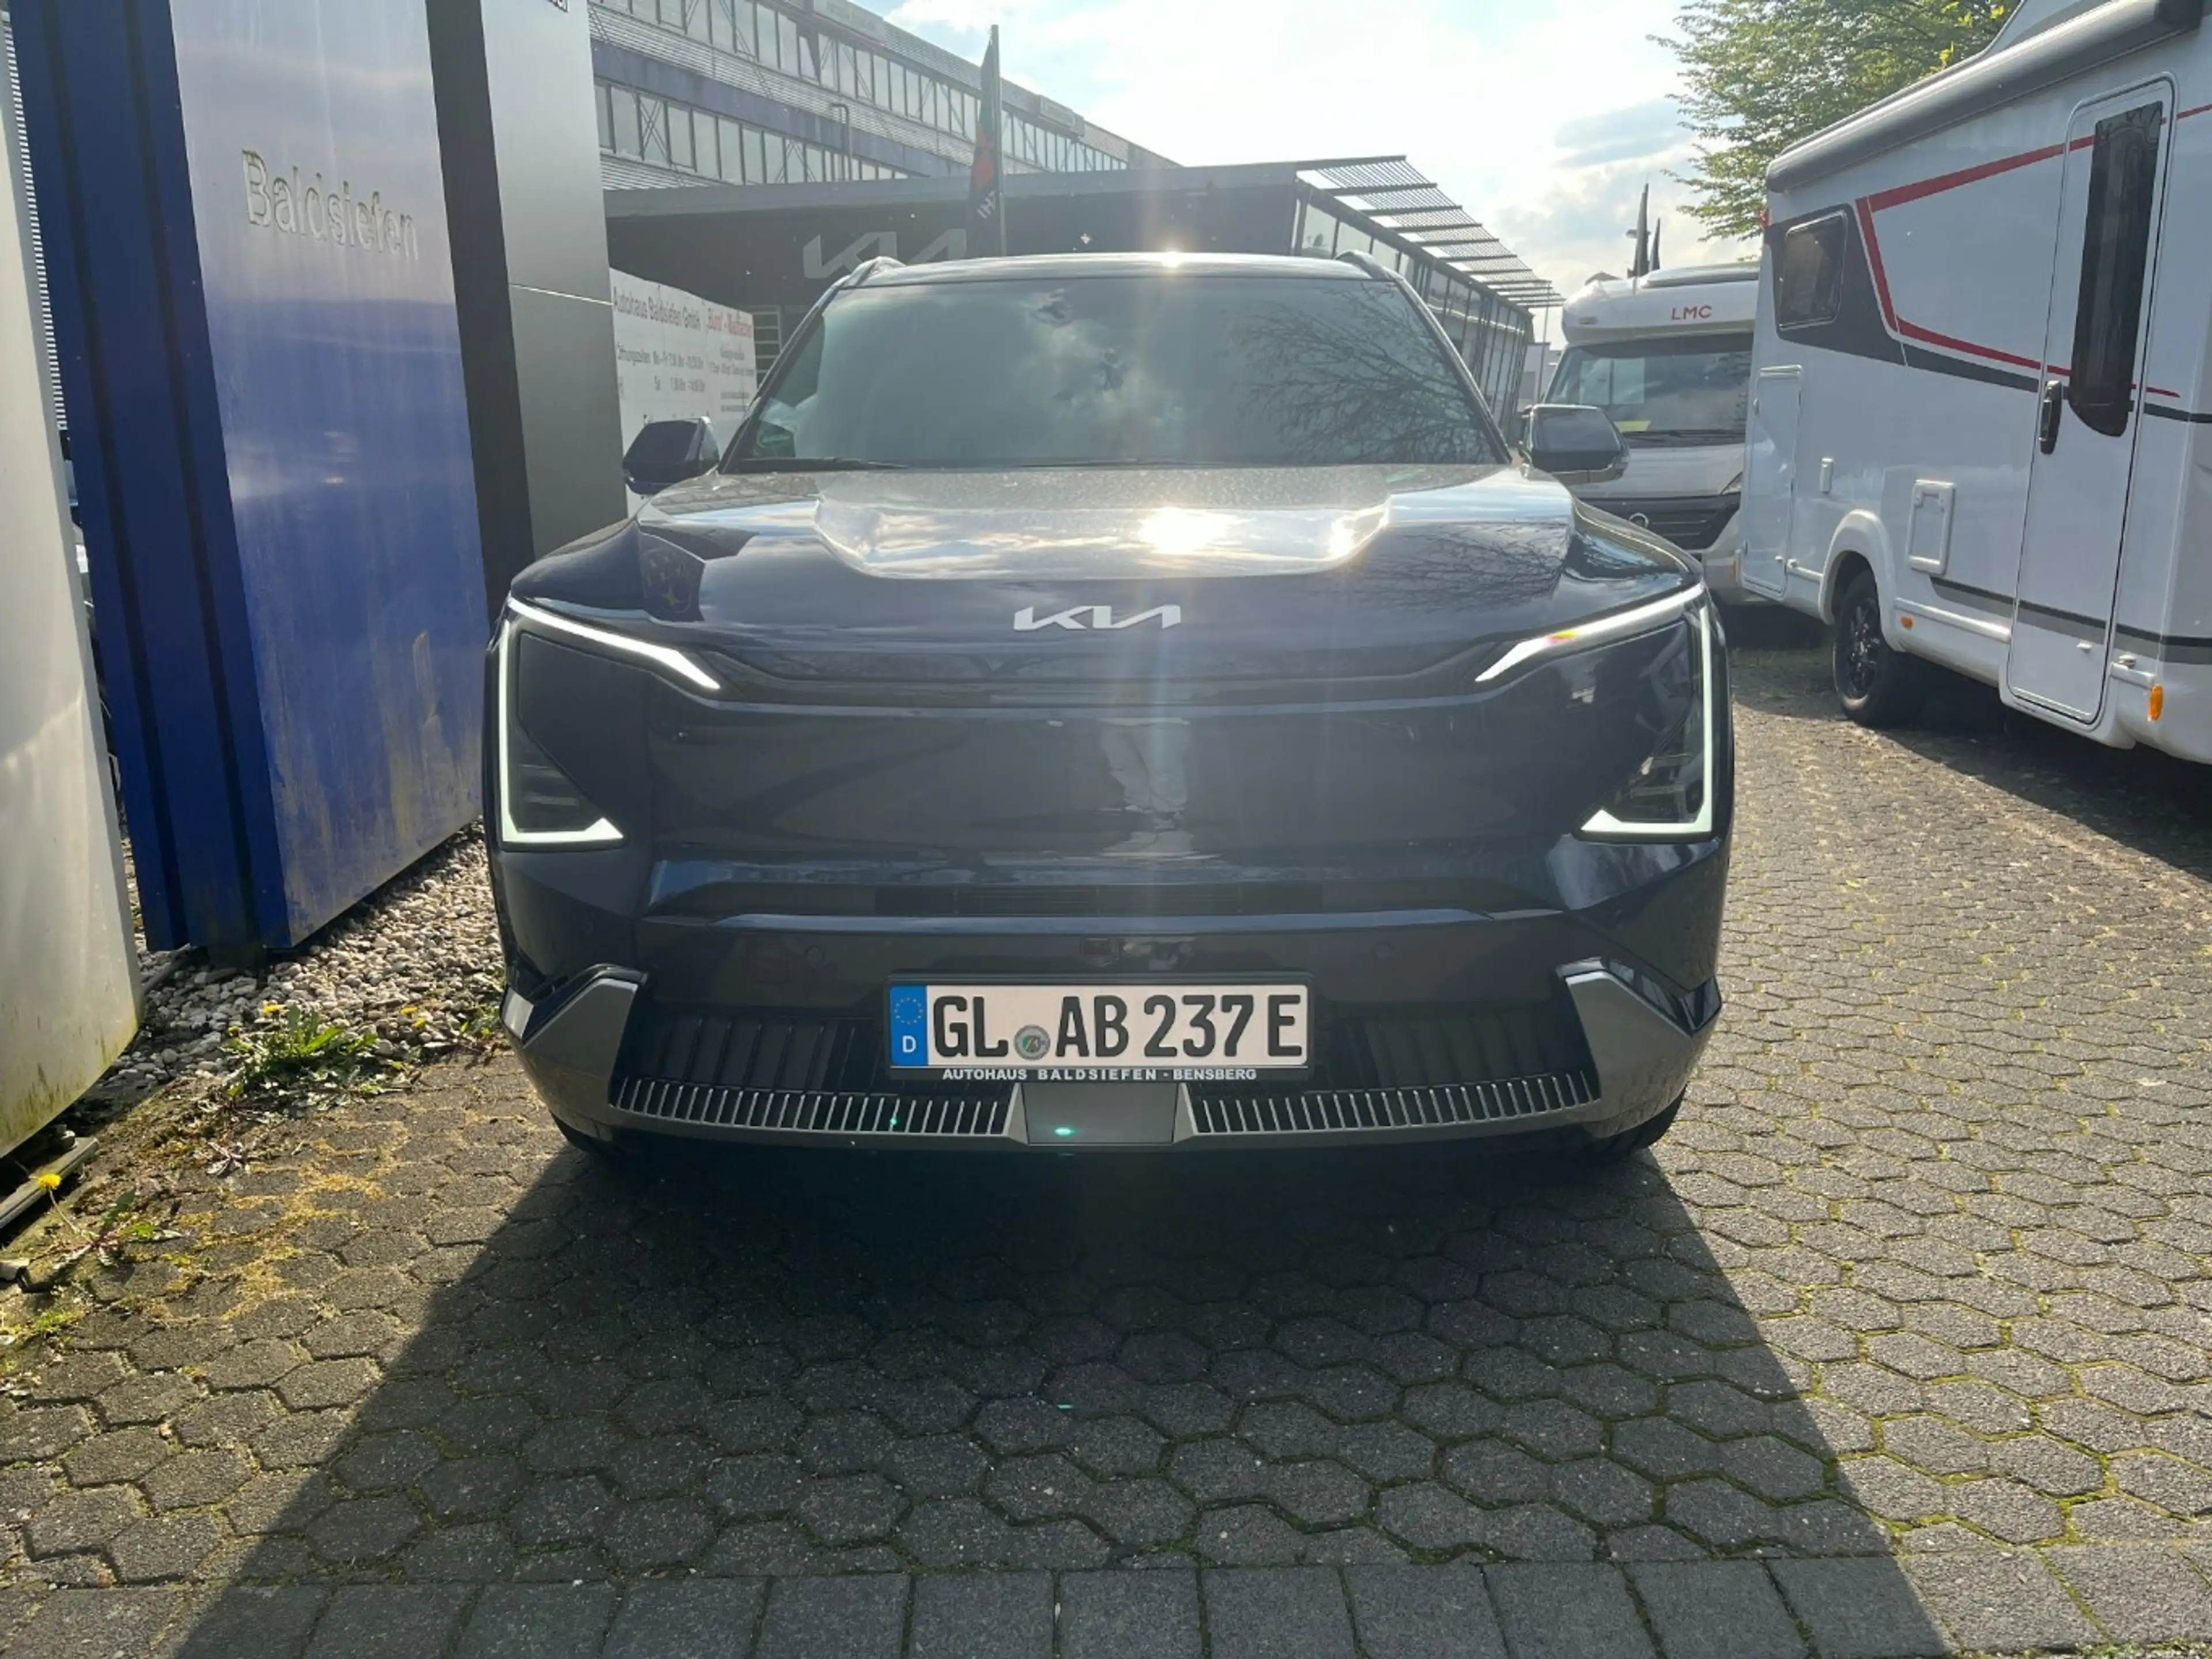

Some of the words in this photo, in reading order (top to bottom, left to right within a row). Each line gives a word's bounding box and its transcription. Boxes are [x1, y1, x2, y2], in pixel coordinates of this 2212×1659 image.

[241, 149, 419, 261] Baldsiefen
[1671, 305, 1713, 320] LMC
[1013, 604, 1181, 631] KIA
[933, 995, 1009, 1058] GL
[1056, 995, 1129, 1058] AB
[902, 1035, 917, 1054] D
[943, 1069, 1027, 1081] AUTOHAUS
[1038, 1069, 1157, 1081] BALDSIEFEN
[1173, 1069, 1257, 1081] BENSBERG
